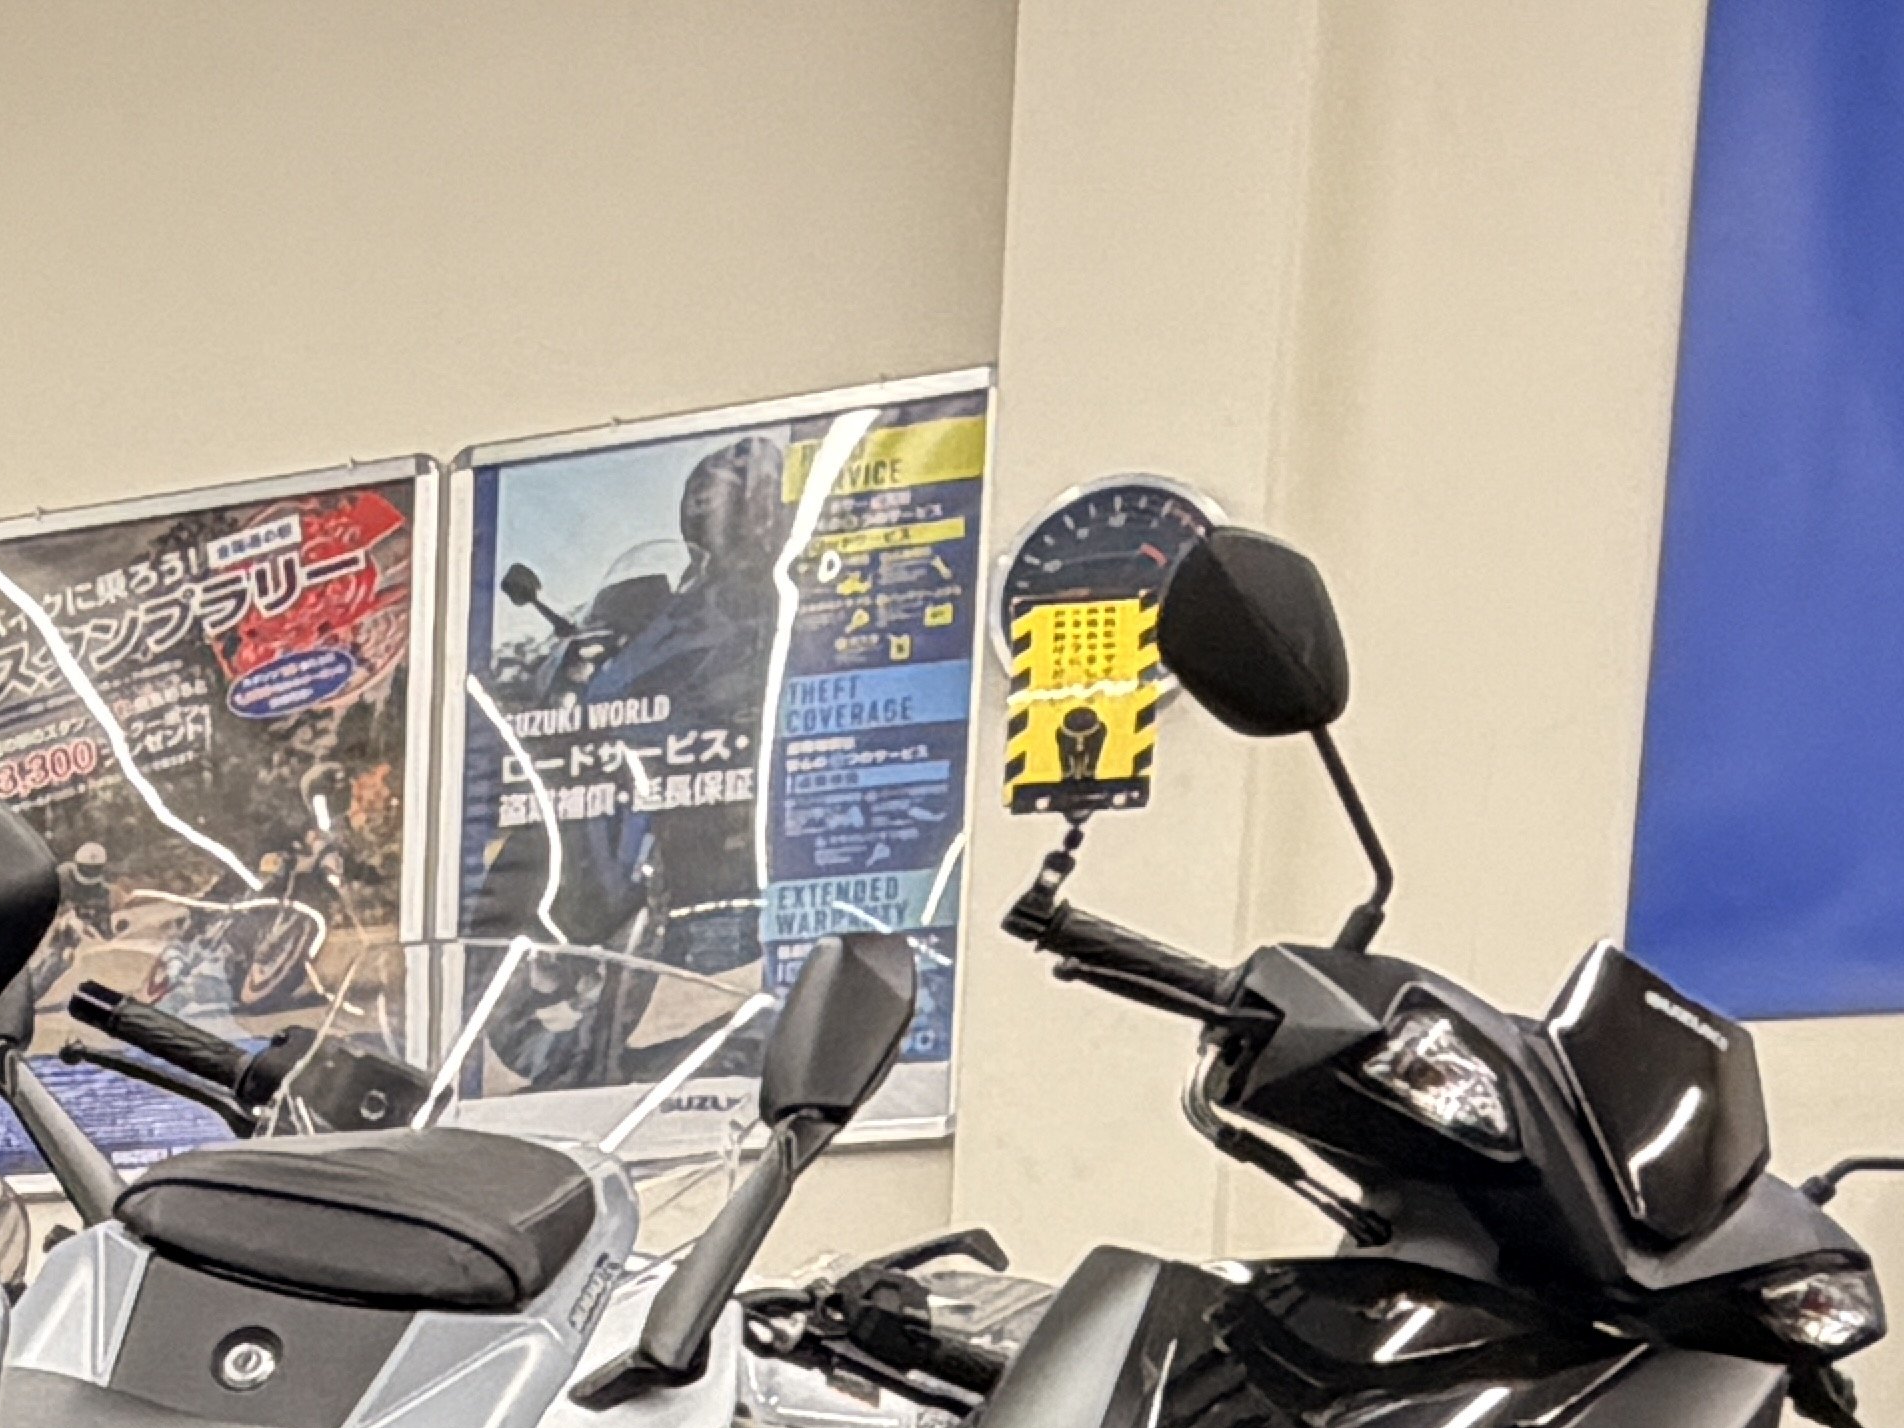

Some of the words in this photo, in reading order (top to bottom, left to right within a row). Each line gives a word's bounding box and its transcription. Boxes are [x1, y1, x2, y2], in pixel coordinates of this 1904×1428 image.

[788, 674, 861, 705] THEFT
[587, 694, 672, 731] WORLD
[785, 695, 915, 733] COVERAGE
[778, 876, 900, 910] EXTENDED
